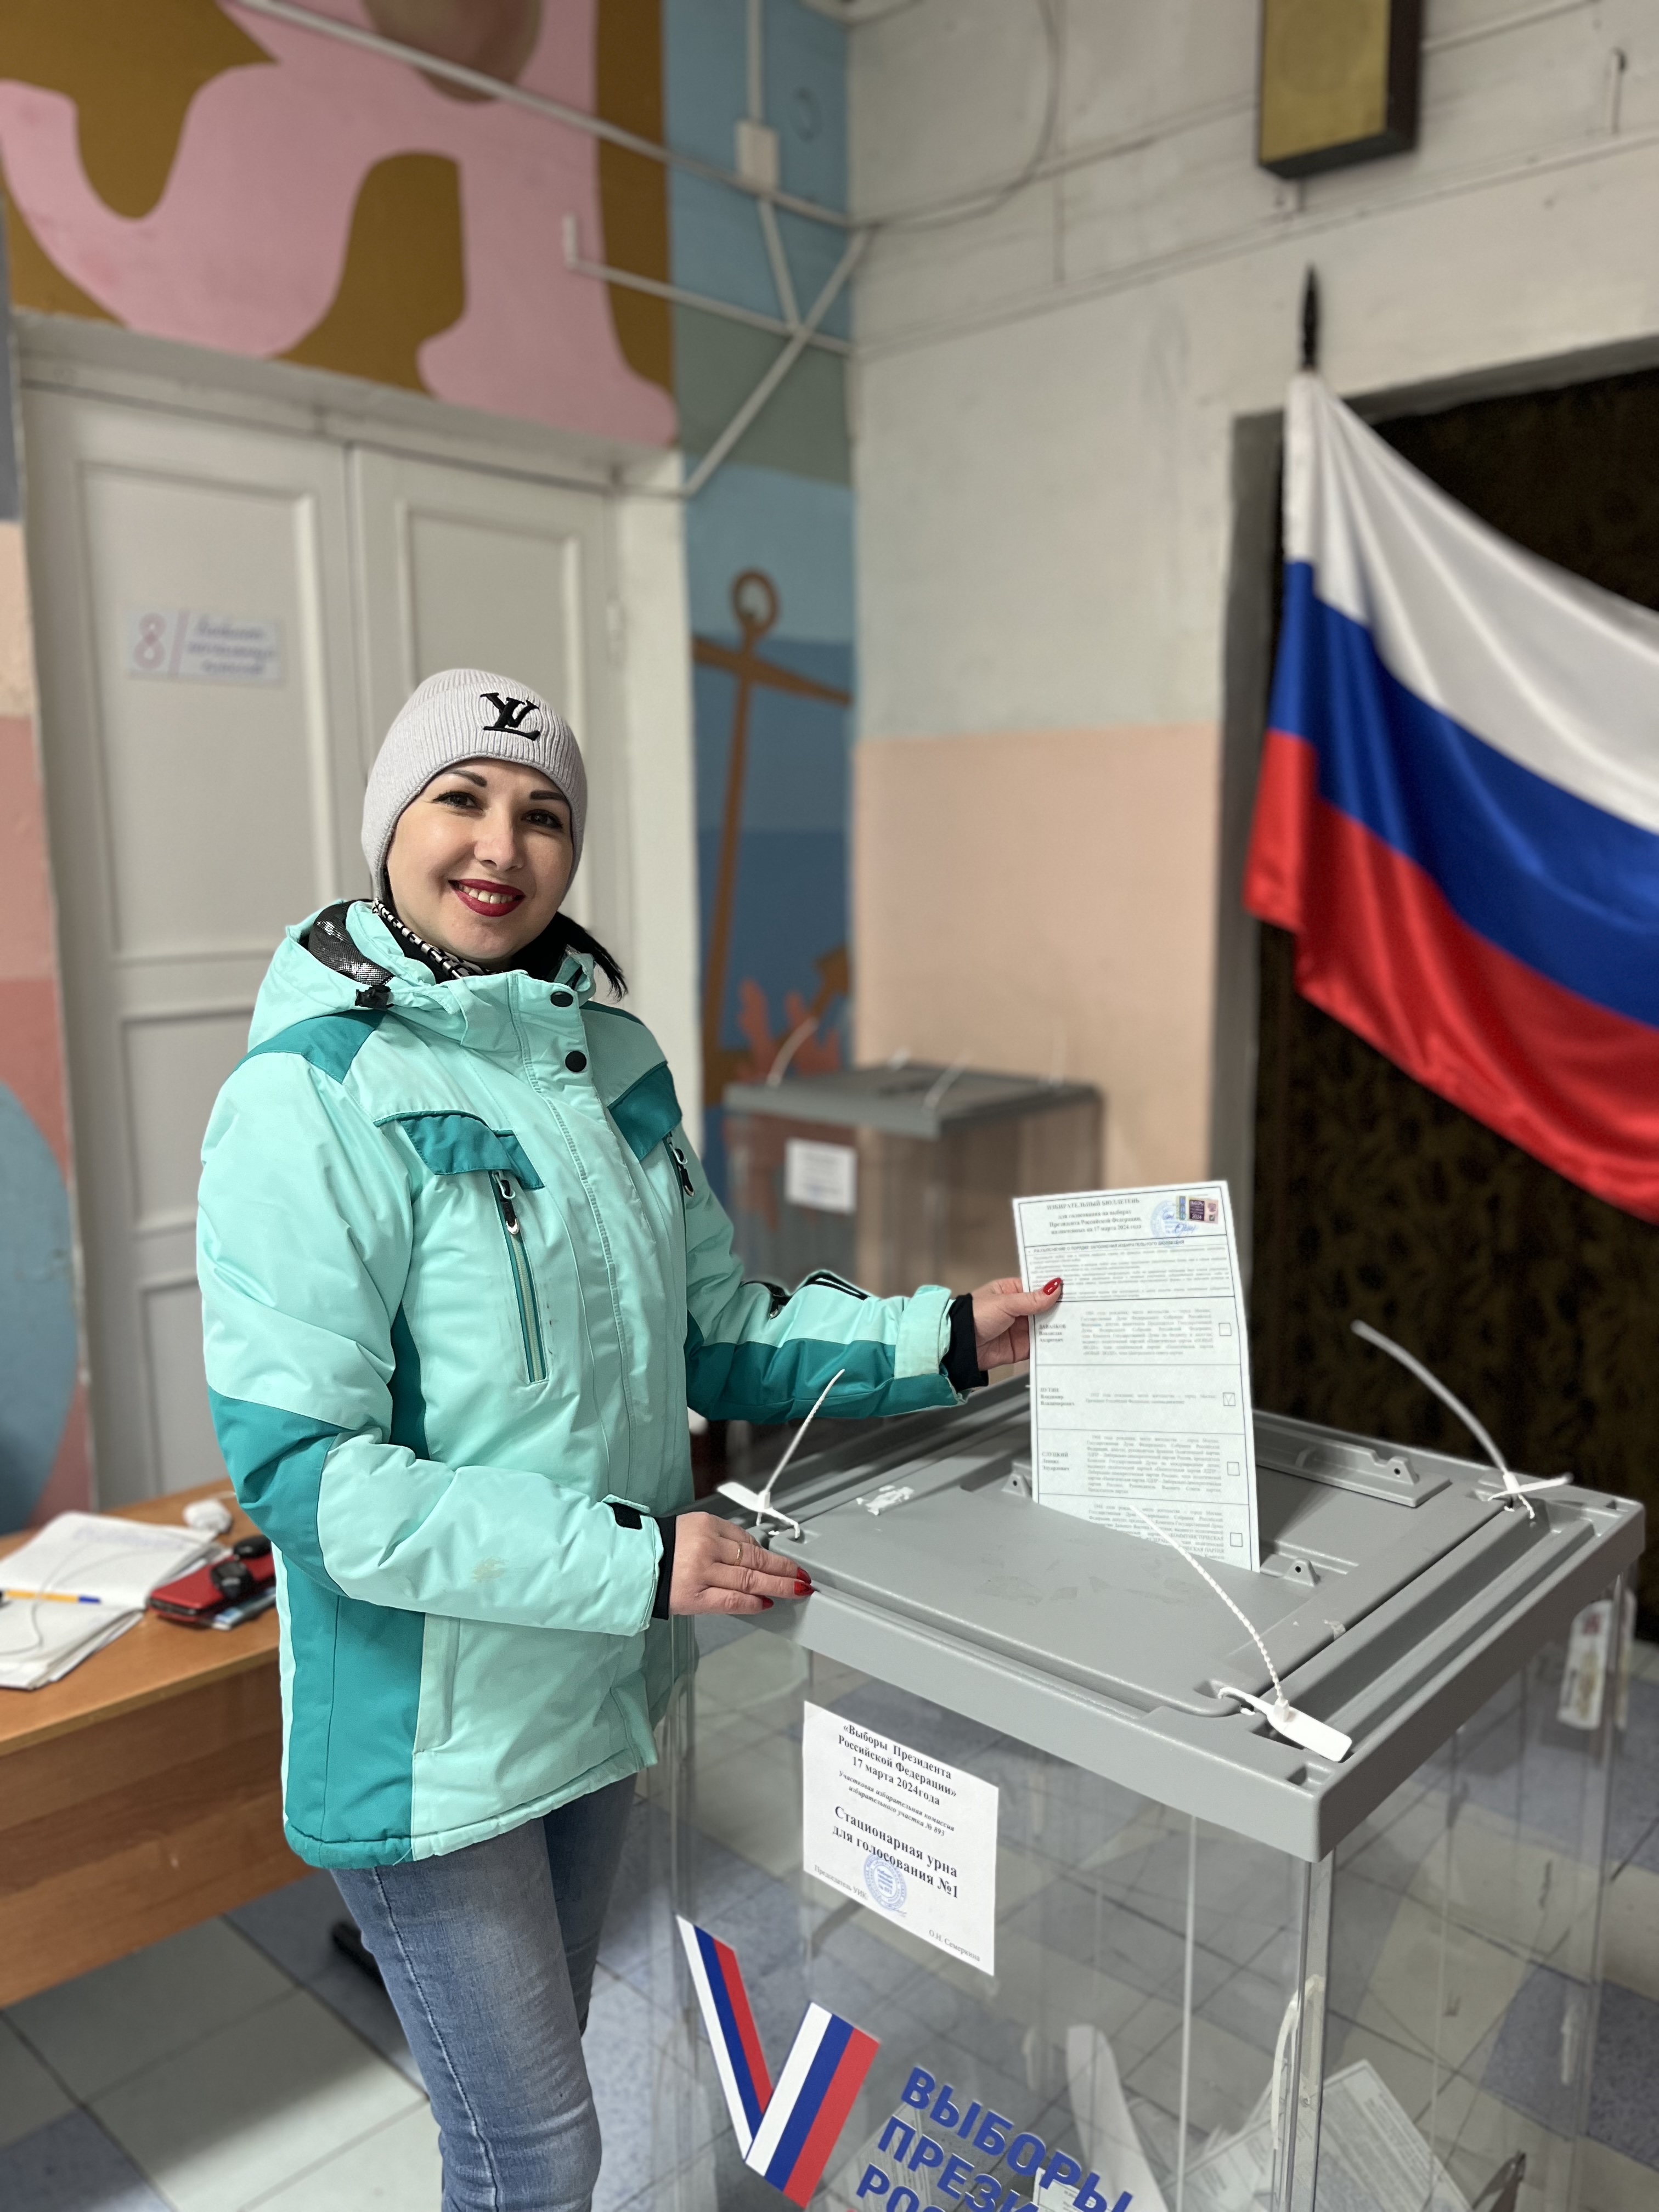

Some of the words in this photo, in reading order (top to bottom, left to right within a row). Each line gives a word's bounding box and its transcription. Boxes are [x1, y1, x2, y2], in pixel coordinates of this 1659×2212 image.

[133, 612, 167, 670] 8
[1047, 1200, 1101, 1210] ИЗБИРАТЕЛЬНЫЙ
[1102, 1198, 1140, 1206] БЮЛЛЕТЕНЬ
[838, 1734, 893, 1768] Российской
[895, 1761, 957, 1797] Федерации»
[843, 1724, 888, 1751] «Выборы
[893, 1745, 951, 1779] Президента
[839, 1770, 874, 1793] Участковая
[876, 1790, 923, 1816] избирательная
[924, 1813, 955, 1831] комиссия
[853, 1756, 863, 1768] 17
[865, 1764, 894, 1784] марта
[897, 1777, 940, 1805] 2024года
[849, 1786, 896, 1813] избирательного
[897, 1809, 924, 1827] участка
[925, 1822, 933, 1831] №
[934, 1826, 945, 1836] 893
[832, 1825, 853, 1843] для
[856, 1837, 934, 1886] голосования
[937, 1876, 958, 1899] №1
[834, 1806, 923, 1861] Стационарная
[927, 1854, 957, 1878] урна
[815, 1865, 852, 1891] Председатель
[929, 1929, 943, 1943] О.Н.
[944, 1938, 980, 1962] Семеркина
[901, 2066, 1133, 2212] ВЫБОРЫ
[856, 2163, 946, 2212] РО
